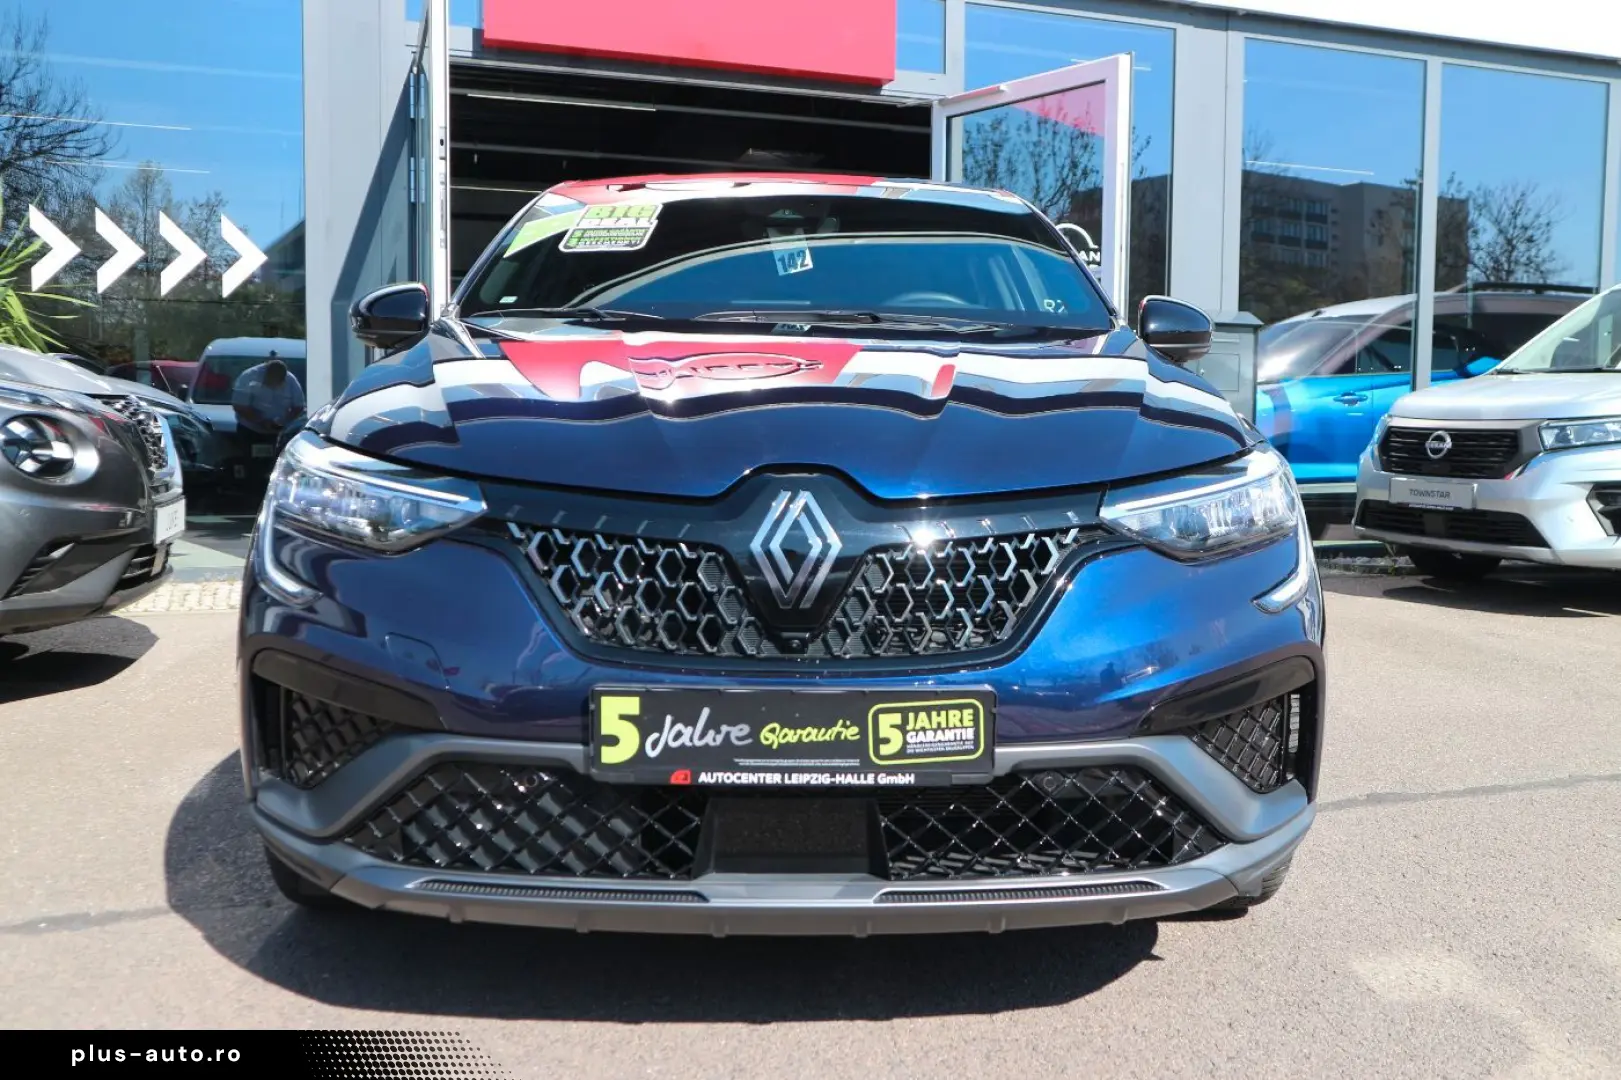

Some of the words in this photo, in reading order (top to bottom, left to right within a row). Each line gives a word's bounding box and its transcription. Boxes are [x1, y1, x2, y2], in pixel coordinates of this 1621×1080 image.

[585, 205, 658, 219] BIG
[778, 249, 810, 273] 142
[1409, 488, 1451, 499] TOWNSTAR
[601, 696, 640, 764] 5
[645, 707, 753, 758] Jahre
[878, 713, 904, 756] 5
[906, 709, 974, 731] JAHRE
[906, 728, 975, 744] GARANTIE
[698, 771, 783, 784] AUTOCENTER
[785, 772, 875, 785] LEIPZIG-HALLE
[877, 773, 915, 785] GmbH
